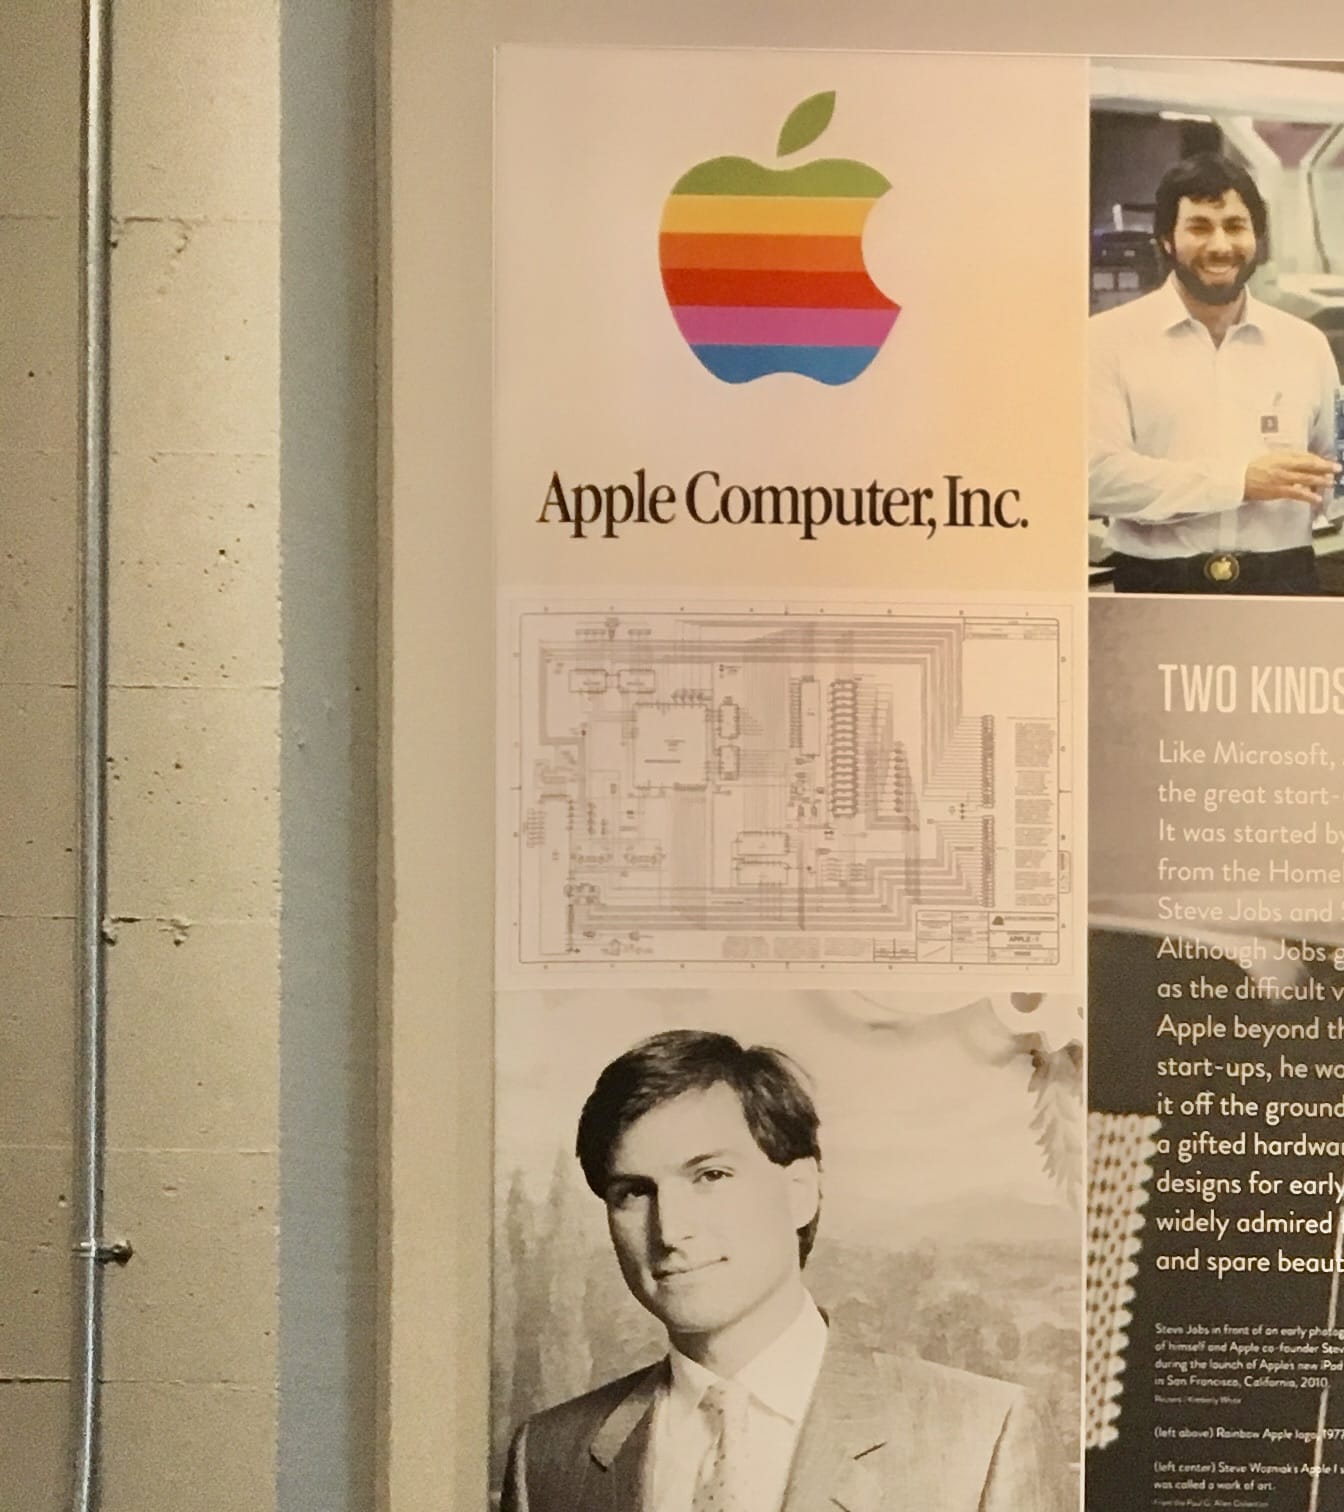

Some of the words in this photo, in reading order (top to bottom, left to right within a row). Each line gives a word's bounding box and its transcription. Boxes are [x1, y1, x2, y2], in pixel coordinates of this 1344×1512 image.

[538, 469, 676, 538] Apple
[686, 471, 936, 540] Computer,
[944, 475, 1028, 528] Inc.
[1158, 664, 1236, 713] TWO
[1159, 739, 1206, 763] Like
[1213, 740, 1335, 771] Microsoft,
[1160, 818, 1175, 842] It
[1183, 828, 1226, 842] was
[1234, 821, 1317, 844] started
[1158, 857, 1214, 881] from
[1221, 859, 1261, 882] the
[1158, 896, 1223, 920] Steve
[1228, 898, 1282, 922] Jobs
[1289, 899, 1333, 923] and
[1157, 937, 1266, 969] Although
[1273, 938, 1326, 961] Jobs
[1157, 1014, 1226, 1045] Apple
[1234, 1015, 1319, 1047] beyond
[1157, 1092, 1173, 1114] it
[1181, 1091, 1215, 1115] off
[1220, 1093, 1258, 1116] the
[1156, 1139, 1170, 1153] a
[1178, 1131, 1246, 1163] gifted
[1157, 1170, 1241, 1202] designs
[1249, 1171, 1283, 1194] for
[1156, 1209, 1230, 1240] widely
[1237, 1210, 1332, 1234] admired
[1156, 1248, 1199, 1270] and
[1207, 1256, 1270, 1279] spare
